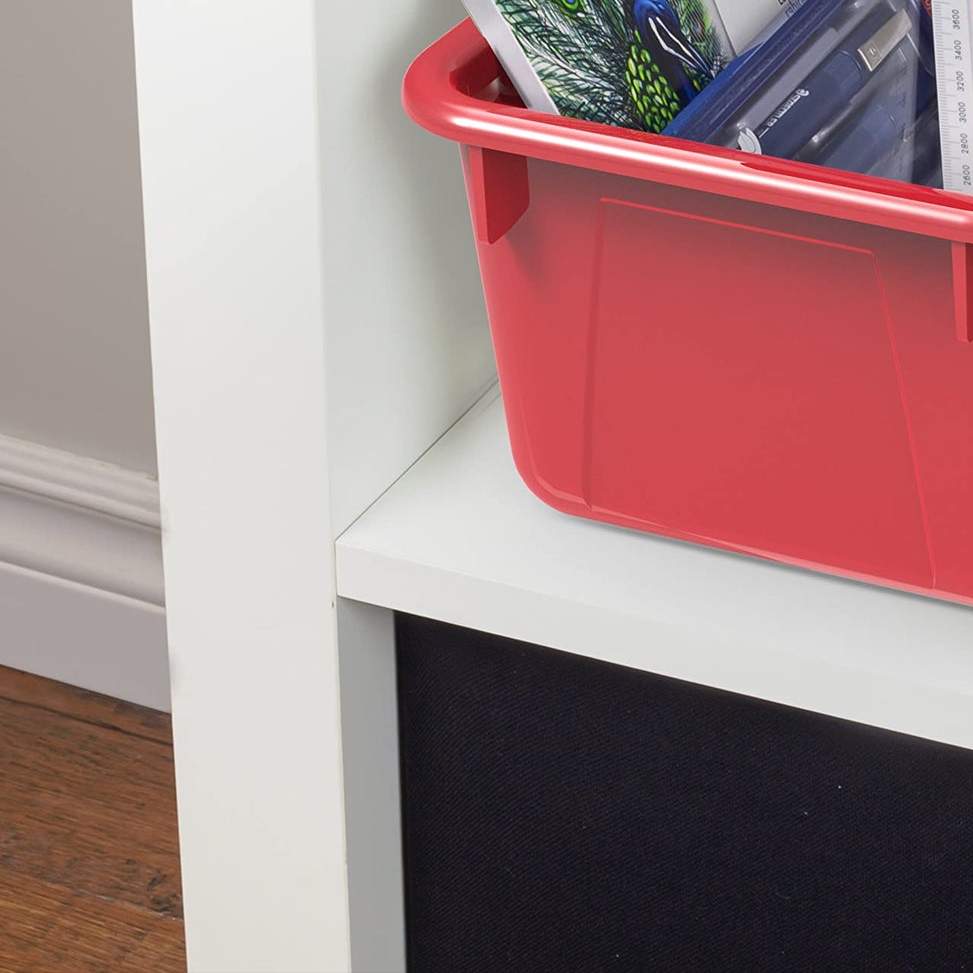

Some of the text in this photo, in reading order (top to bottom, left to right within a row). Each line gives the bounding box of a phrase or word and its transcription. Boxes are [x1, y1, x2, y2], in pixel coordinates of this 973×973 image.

[952, 9, 960, 30] 3600
[954, 40, 962, 60] 3400
[956, 71, 964, 92] 3200
[958, 102, 966, 122] 3000
[960, 133, 969, 154] 2800
[962, 164, 971, 186] 2600
